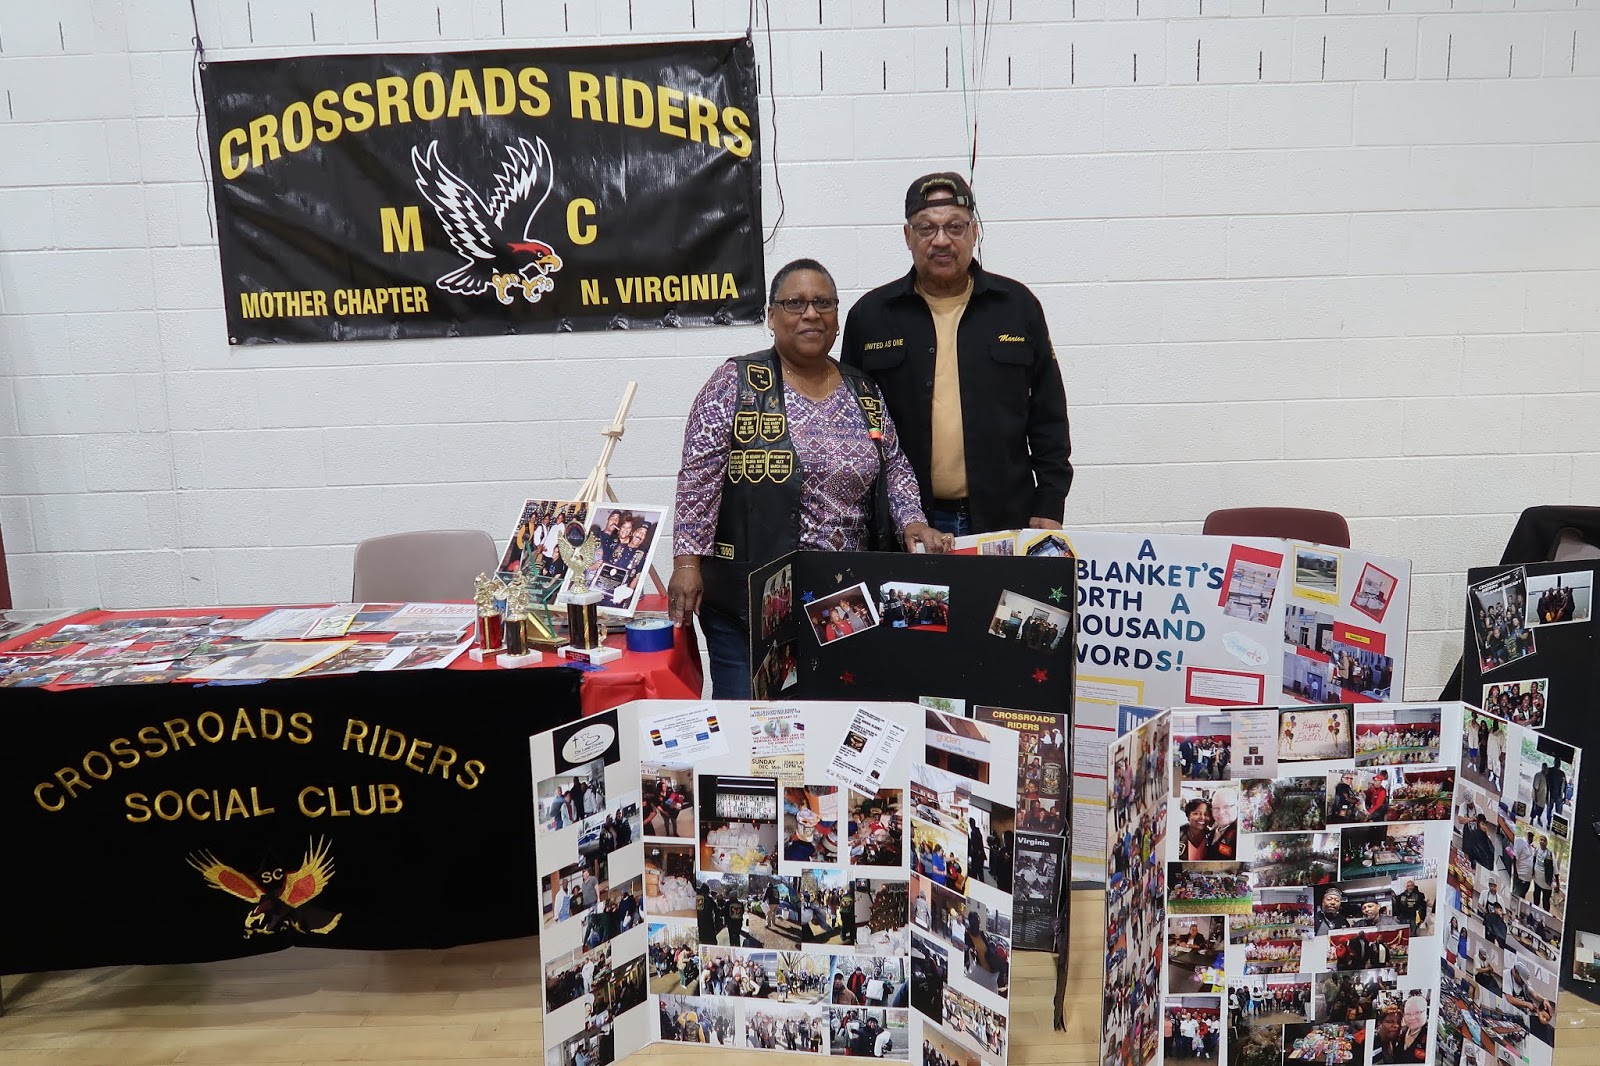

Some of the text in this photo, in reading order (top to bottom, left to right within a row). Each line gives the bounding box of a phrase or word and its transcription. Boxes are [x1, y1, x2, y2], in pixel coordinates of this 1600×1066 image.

[219, 67, 753, 180] CROSSROADS RIDERS
[380, 206, 425, 253] M
[566, 197, 597, 245] C
[581, 273, 739, 305] N. VIRGINIA
[241, 286, 429, 319] MOTHER CHAPTER
[864, 338, 904, 351] UNITED AS ONE
[1137, 539, 1157, 561] A
[1170, 593, 1190, 615] A
[992, 710, 1056, 724] CROSSROADS
[1007, 721, 1040, 732] RIDERS
[1301, 719, 1322, 732] Happy
[33, 707, 486, 813] CROSSROADS RIDERS
[125, 783, 403, 823] SOCIAL CLUB
[1017, 836, 1050, 847] Virginia
[261, 868, 284, 884] SC
